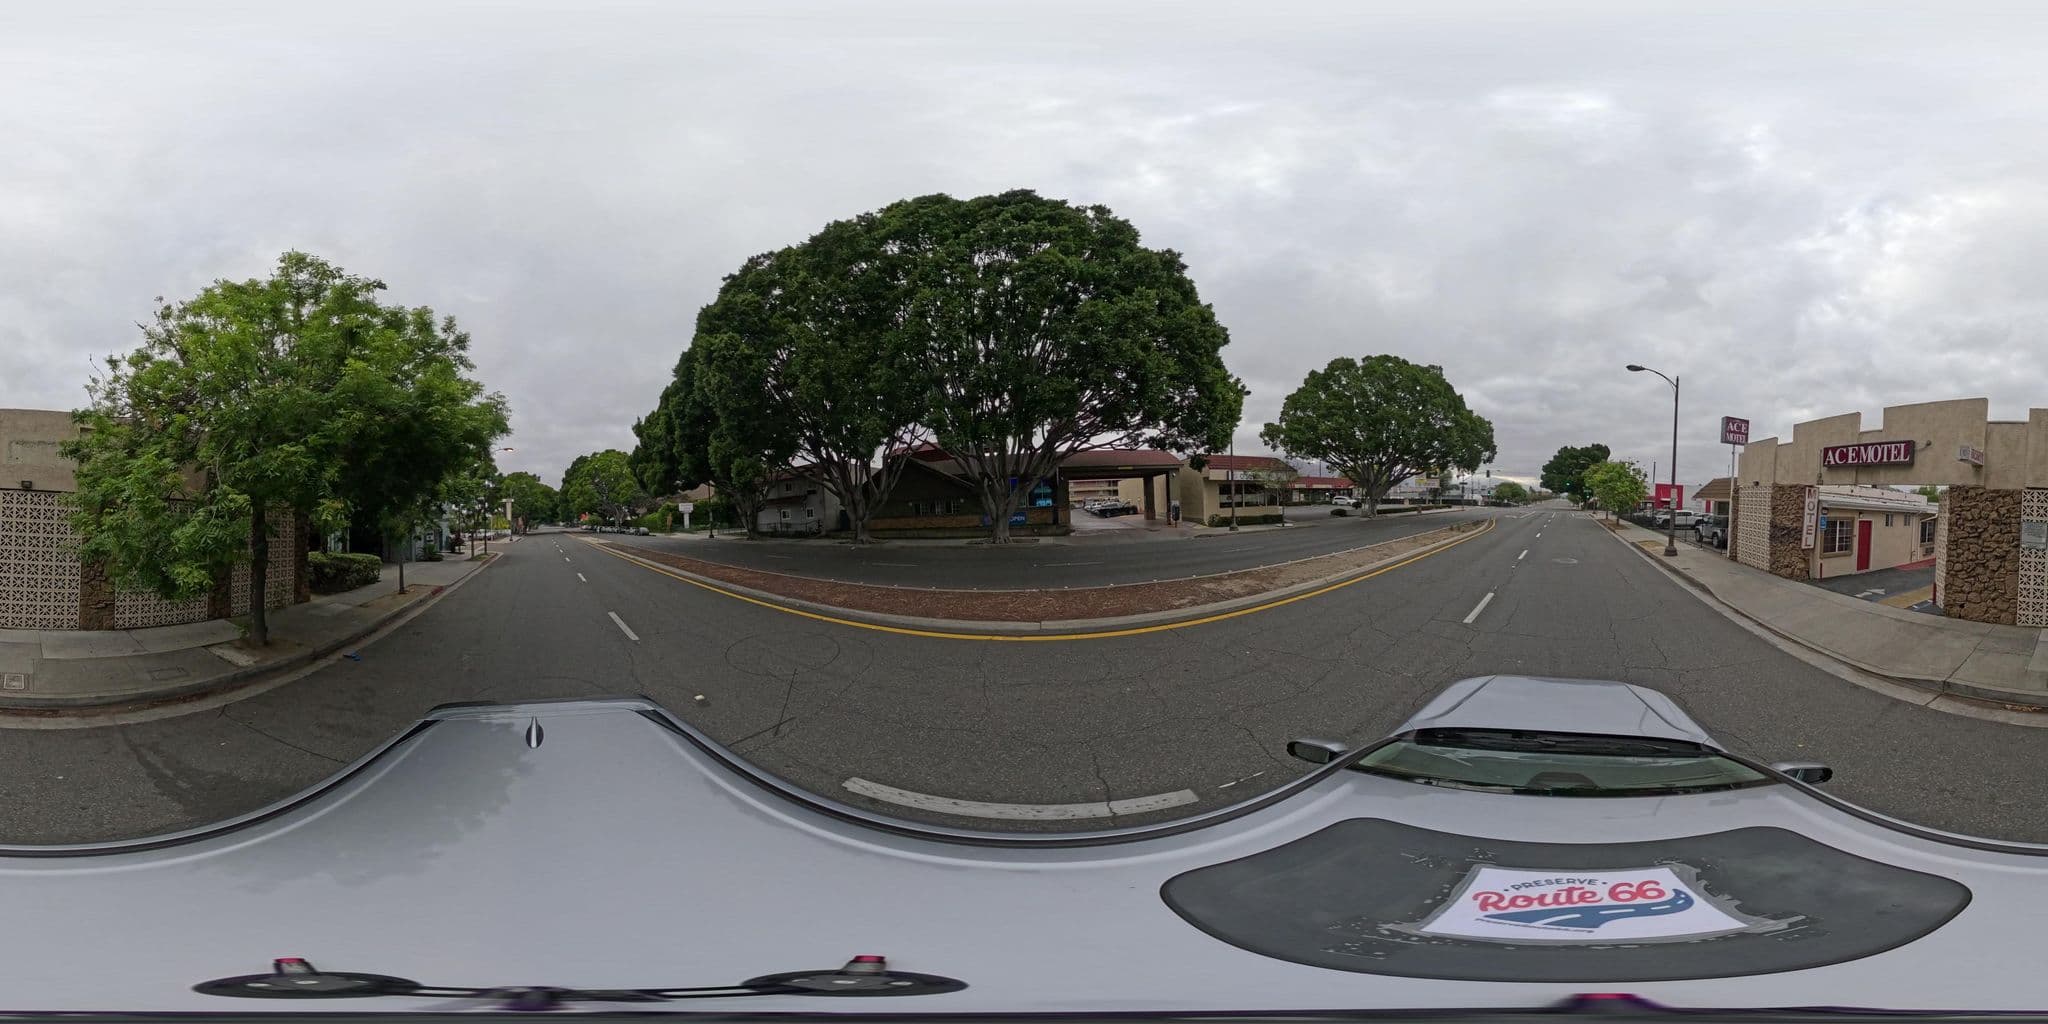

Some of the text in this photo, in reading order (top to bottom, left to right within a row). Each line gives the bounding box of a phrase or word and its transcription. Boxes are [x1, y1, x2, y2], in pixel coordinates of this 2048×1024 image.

[1727, 421, 1747, 433] ACE
[1726, 432, 1745, 443] MOTEL
[1824, 443, 1910, 465] ACE MOTEL
[1804, 488, 1817, 547] MOTEL
[1511, 878, 1599, 891] PRESERVE
[1472, 880, 1666, 912] Route 66
